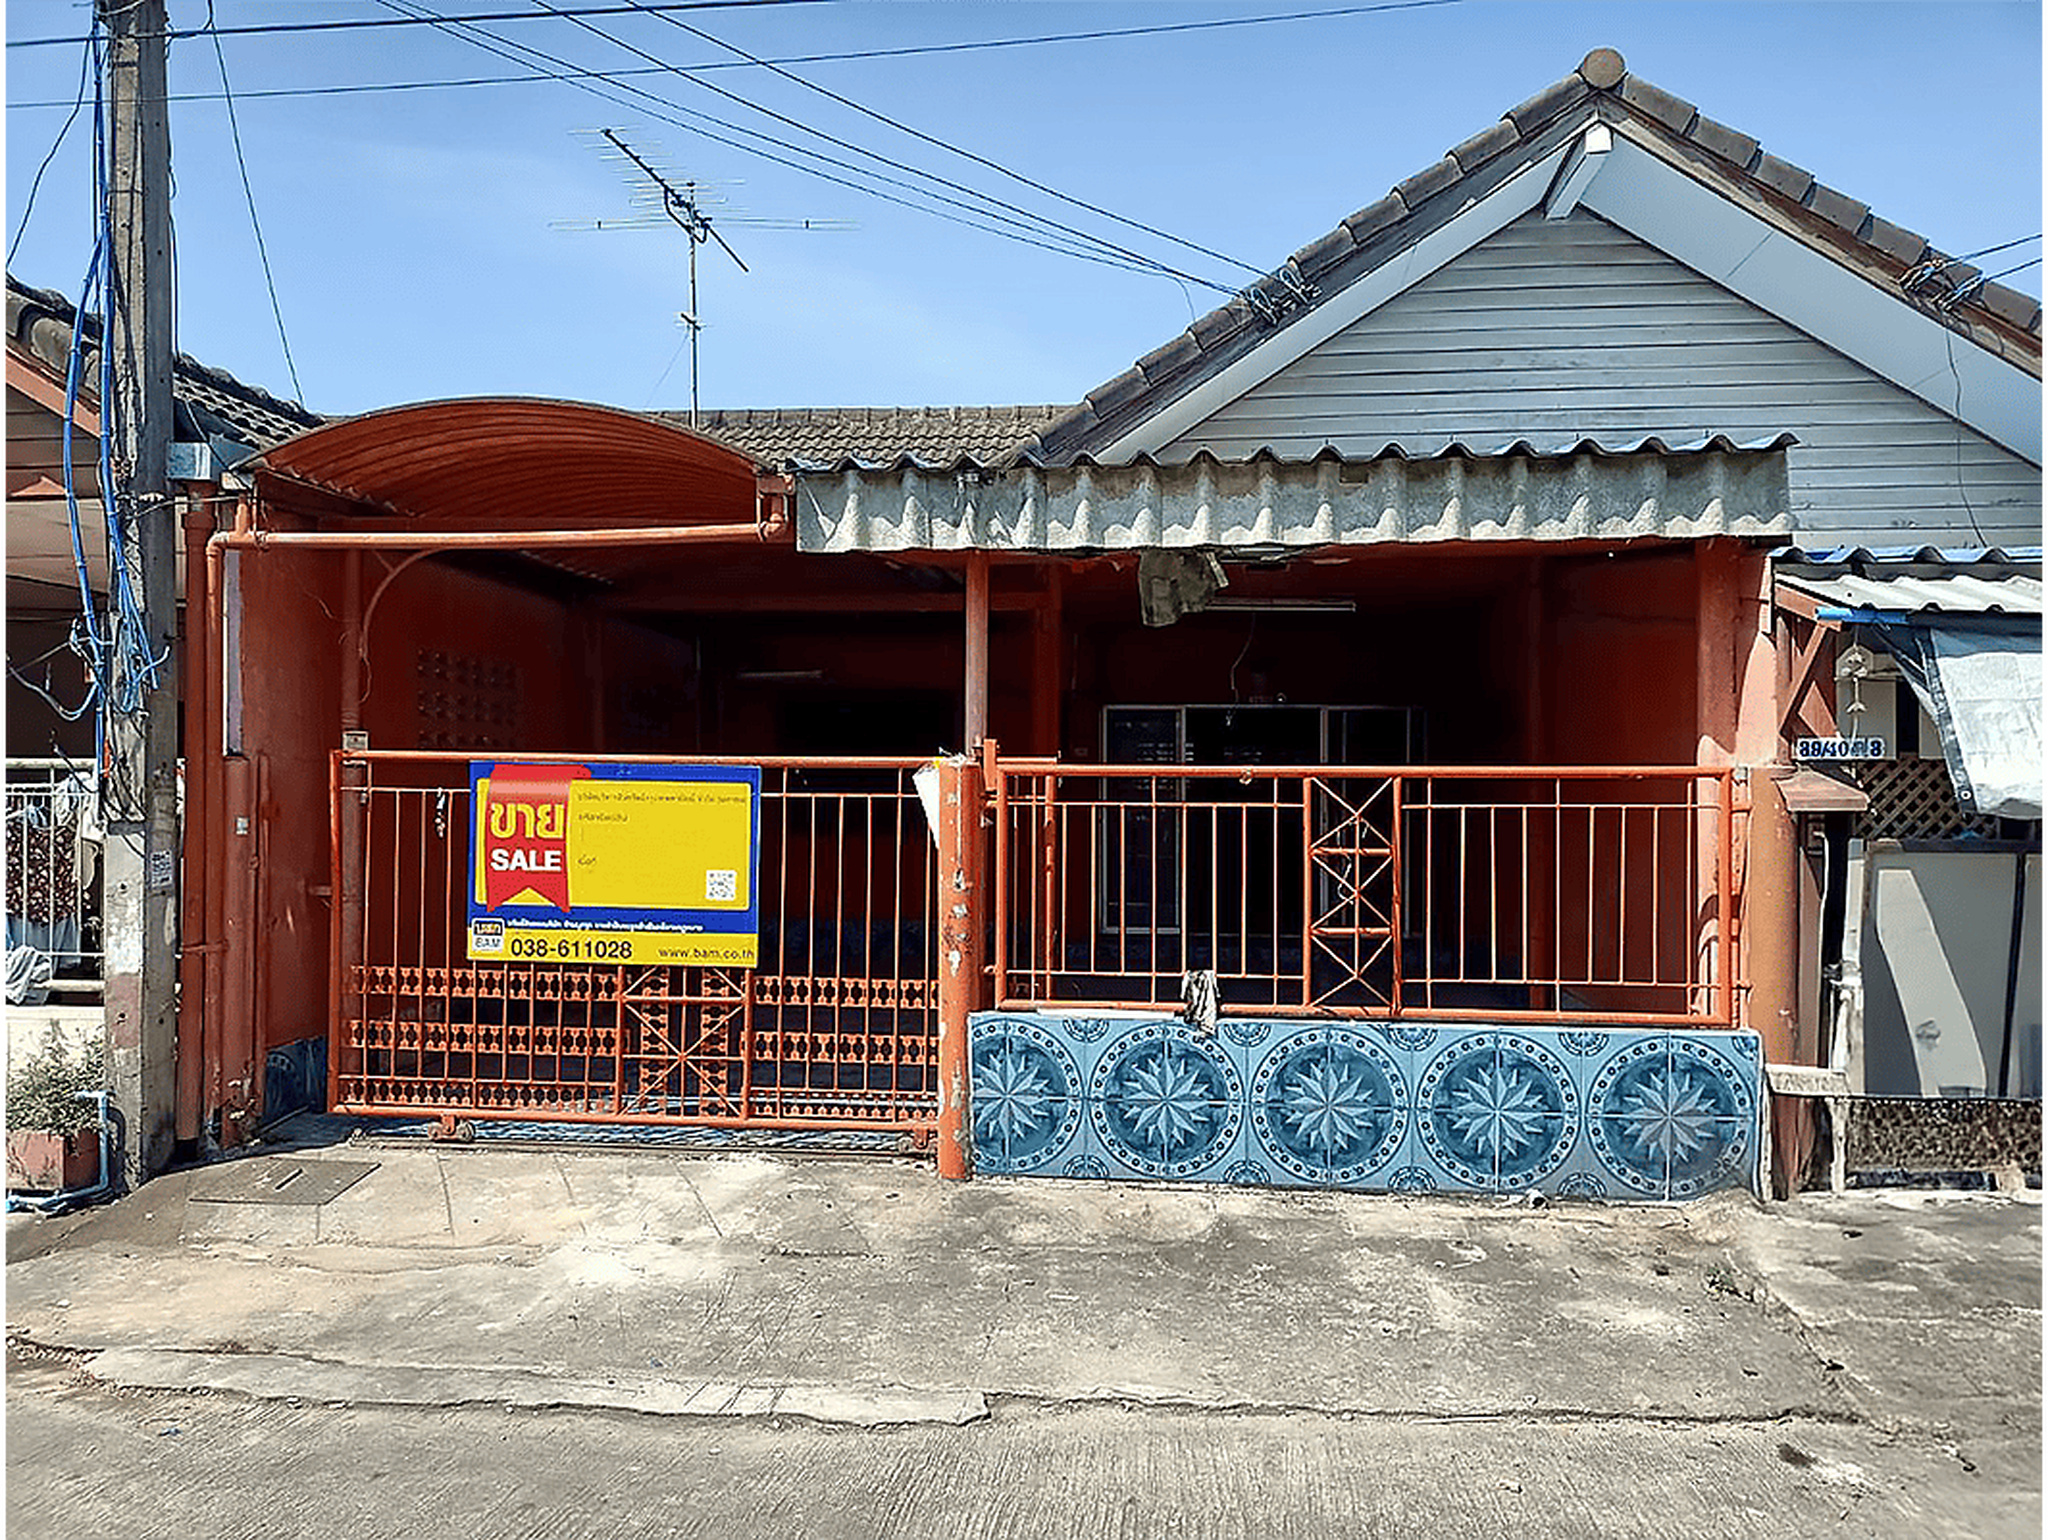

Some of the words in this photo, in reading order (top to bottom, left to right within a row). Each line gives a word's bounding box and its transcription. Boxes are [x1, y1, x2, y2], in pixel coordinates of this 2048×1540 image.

[490, 803, 565, 838] ขาย
[490, 848, 562, 871] SALE
[511, 938, 632, 959] 038-611028
